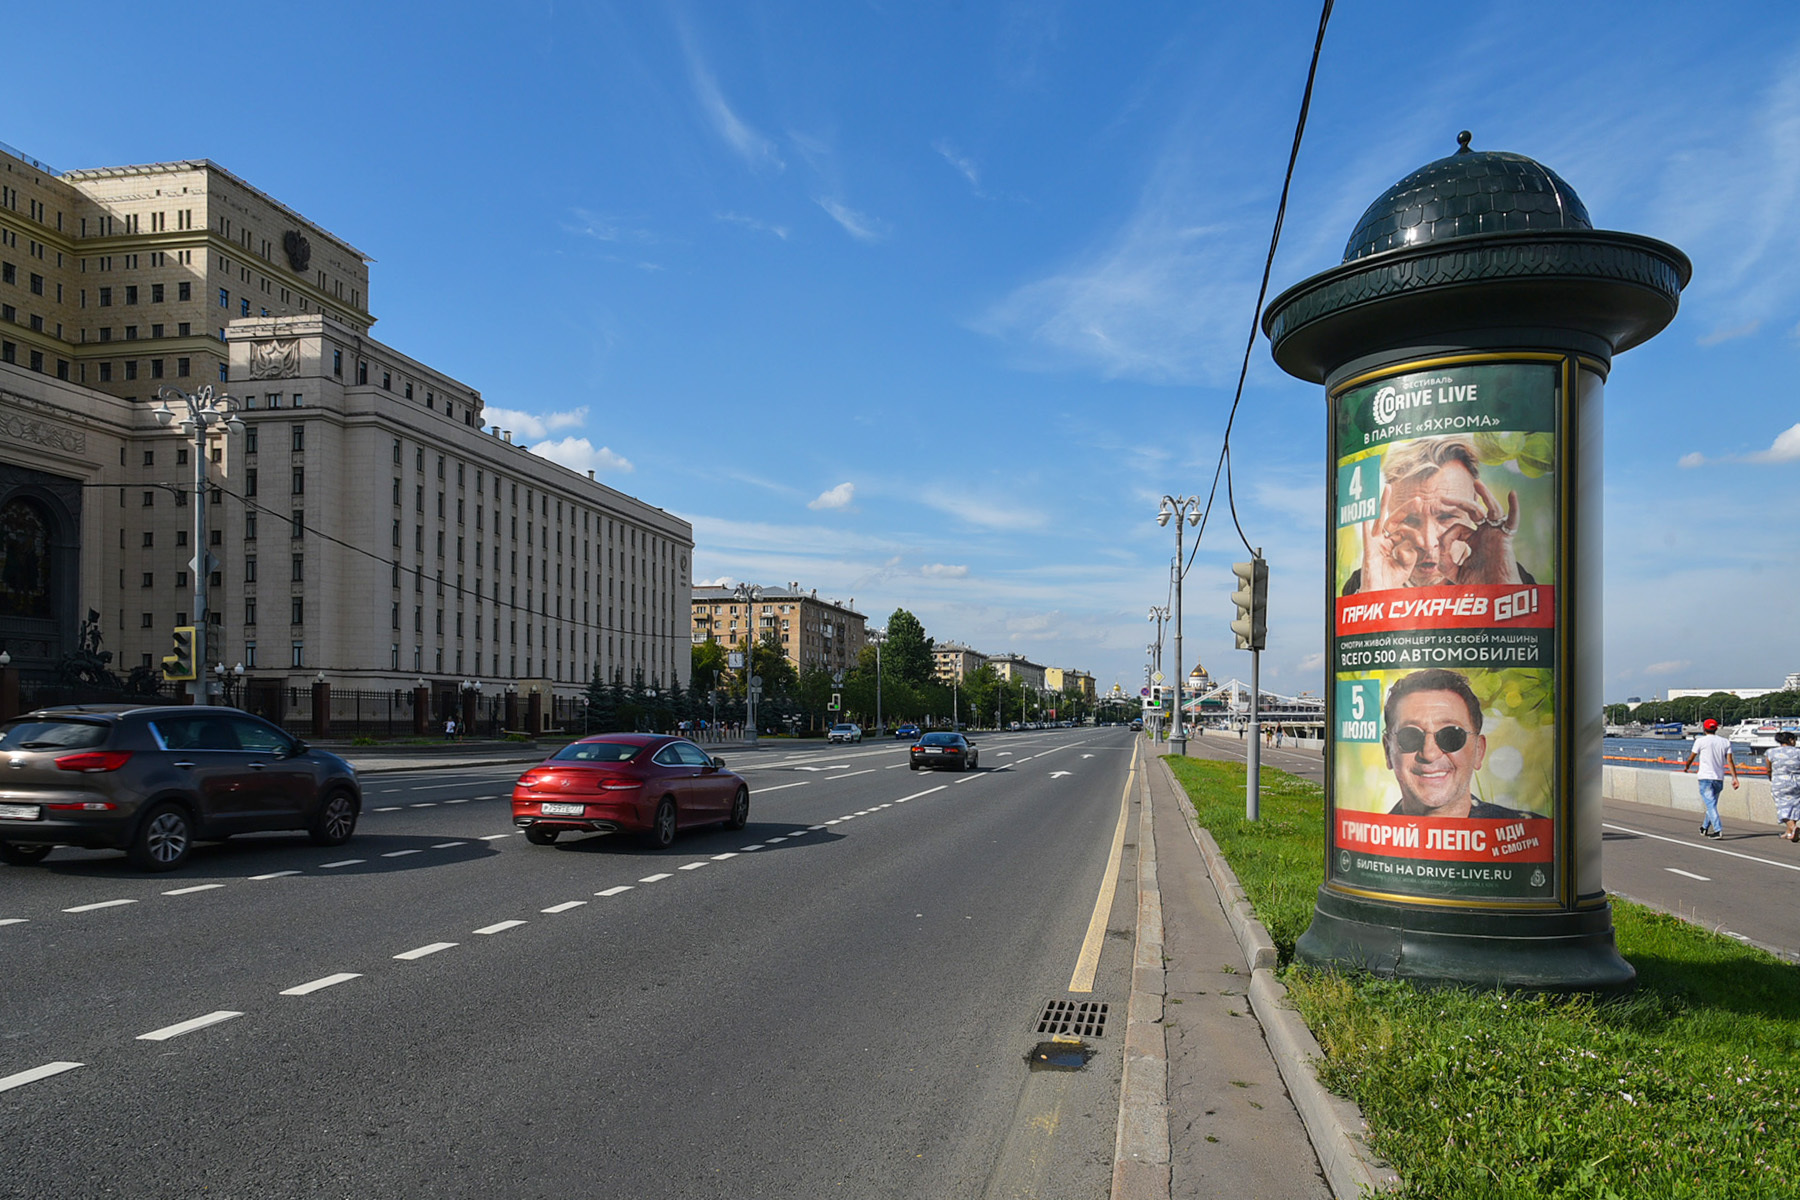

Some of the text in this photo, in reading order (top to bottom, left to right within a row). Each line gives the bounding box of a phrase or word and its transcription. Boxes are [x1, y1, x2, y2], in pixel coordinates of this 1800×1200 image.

[1386, 385, 1477, 413] DRIVE LIVE
[1364, 415, 1500, 444] В ПАРКЕ «ЯХРОМА»
[1348, 466, 1362, 500] 4
[1340, 498, 1376, 524] ИЮЛЯ
[1342, 594, 1488, 624] ГАРИК СУКАЧЁВ
[1494, 588, 1538, 621] GO!
[1340, 634, 1538, 650] СМОТРИ ЖИВОЙ КОНЦЕРТ ИЗ СВОЕЙ МАШИНЫ
[1342, 646, 1539, 666] ВСЕГО 500 АВТОМОБИЛЕЙ
[1352, 684, 1364, 720] 5
[1342, 720, 1376, 740] ИЮЛЯ
[1342, 820, 1486, 852] ГРИГОРИЙ ЛЕПС
[1495, 822, 1525, 842] ИДИ
[1492, 838, 1539, 857] И СМОТРИ
[1356, 858, 1512, 880] БИЛЕТЫ НА DRIVE-LIVE.RU
